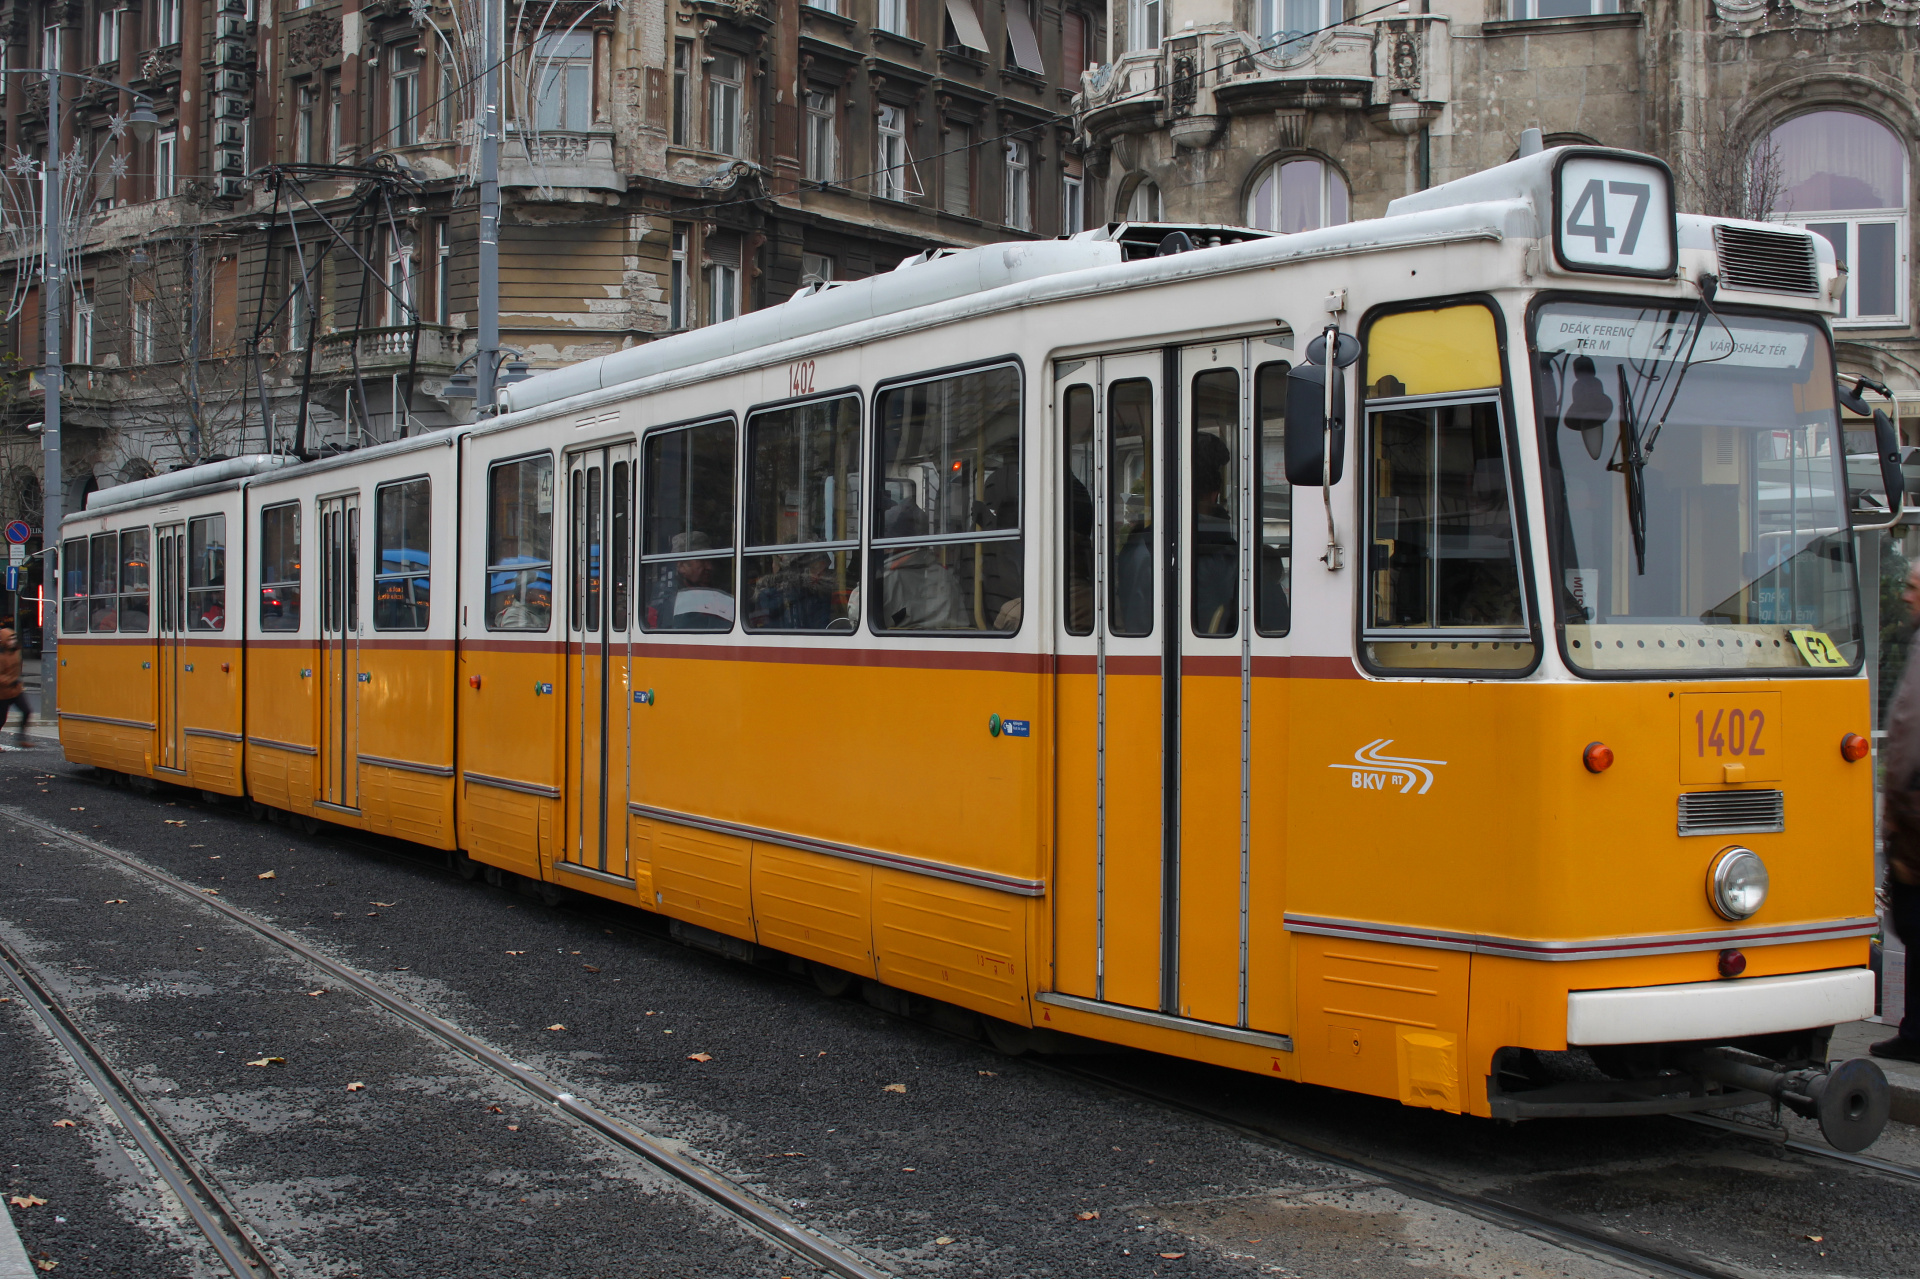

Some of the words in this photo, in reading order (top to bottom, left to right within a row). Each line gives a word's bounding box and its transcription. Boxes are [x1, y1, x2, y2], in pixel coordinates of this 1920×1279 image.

[1566, 179, 1650, 255] 47
[1560, 321, 1591, 335] DEÁK
[1593, 325, 1635, 338] FERENC
[1577, 336, 1596, 349] TÉR
[1599, 340, 1611, 350] M
[1652, 328, 1694, 356] 47
[1710, 340, 1766, 354] VÁROSHÁZ
[1769, 343, 1787, 356] TÉR
[789, 359, 815, 398] 1402
[1804, 636, 1838, 664] F2
[1696, 708, 1765, 757] 1402
[1351, 771, 1387, 791] BKV
[1391, 775, 1404, 785] RT
